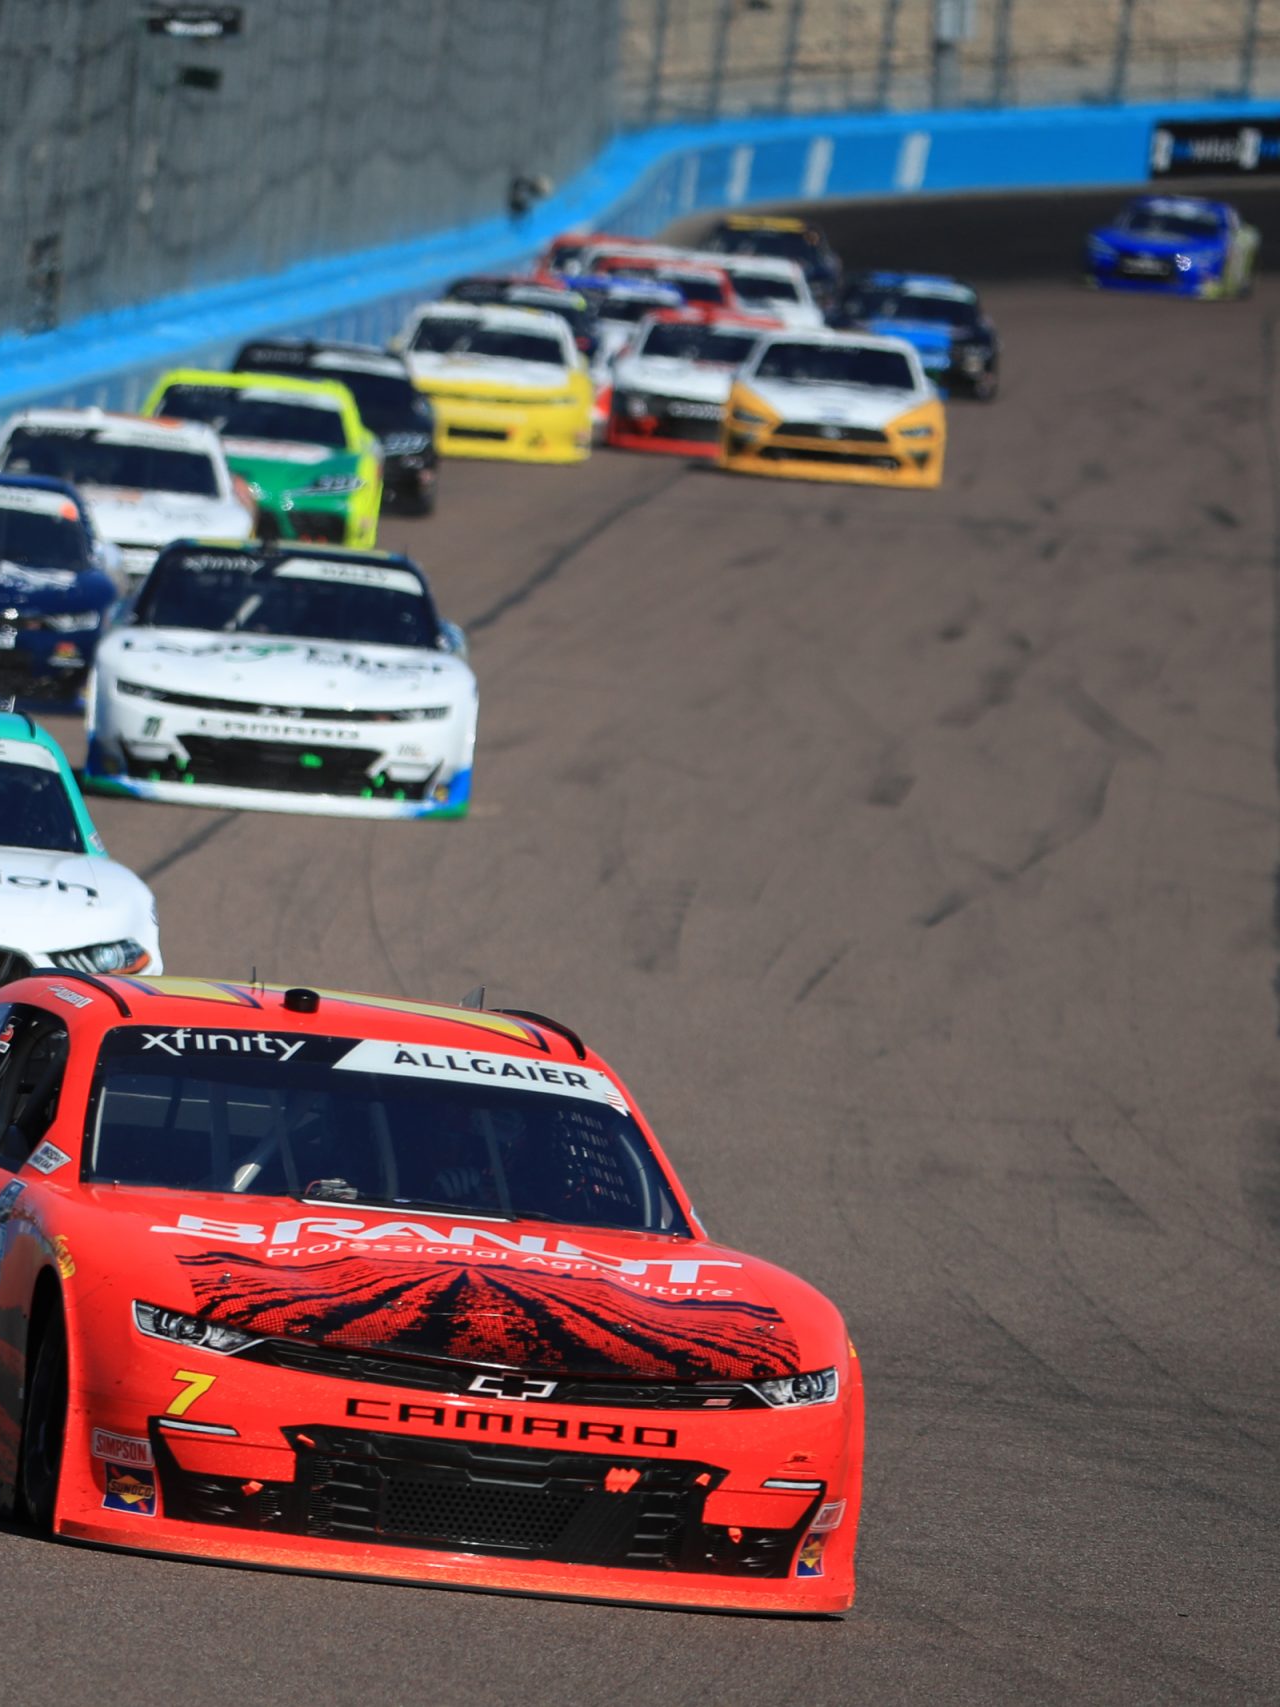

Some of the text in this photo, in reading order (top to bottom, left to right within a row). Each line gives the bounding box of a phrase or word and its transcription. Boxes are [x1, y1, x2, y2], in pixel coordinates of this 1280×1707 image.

[141, 1028, 306, 1061] xfinity
[393, 1050, 591, 1090] ALLGAIER
[149, 1214, 742, 1284] BRANDT
[266, 1240, 734, 1297] Professional Agriculture
[165, 1369, 217, 1416] 7
[345, 1398, 677, 1448] CAMARO
[96, 1434, 147, 1462] SIMPSON
[111, 1480, 153, 1498] SUNOCO
